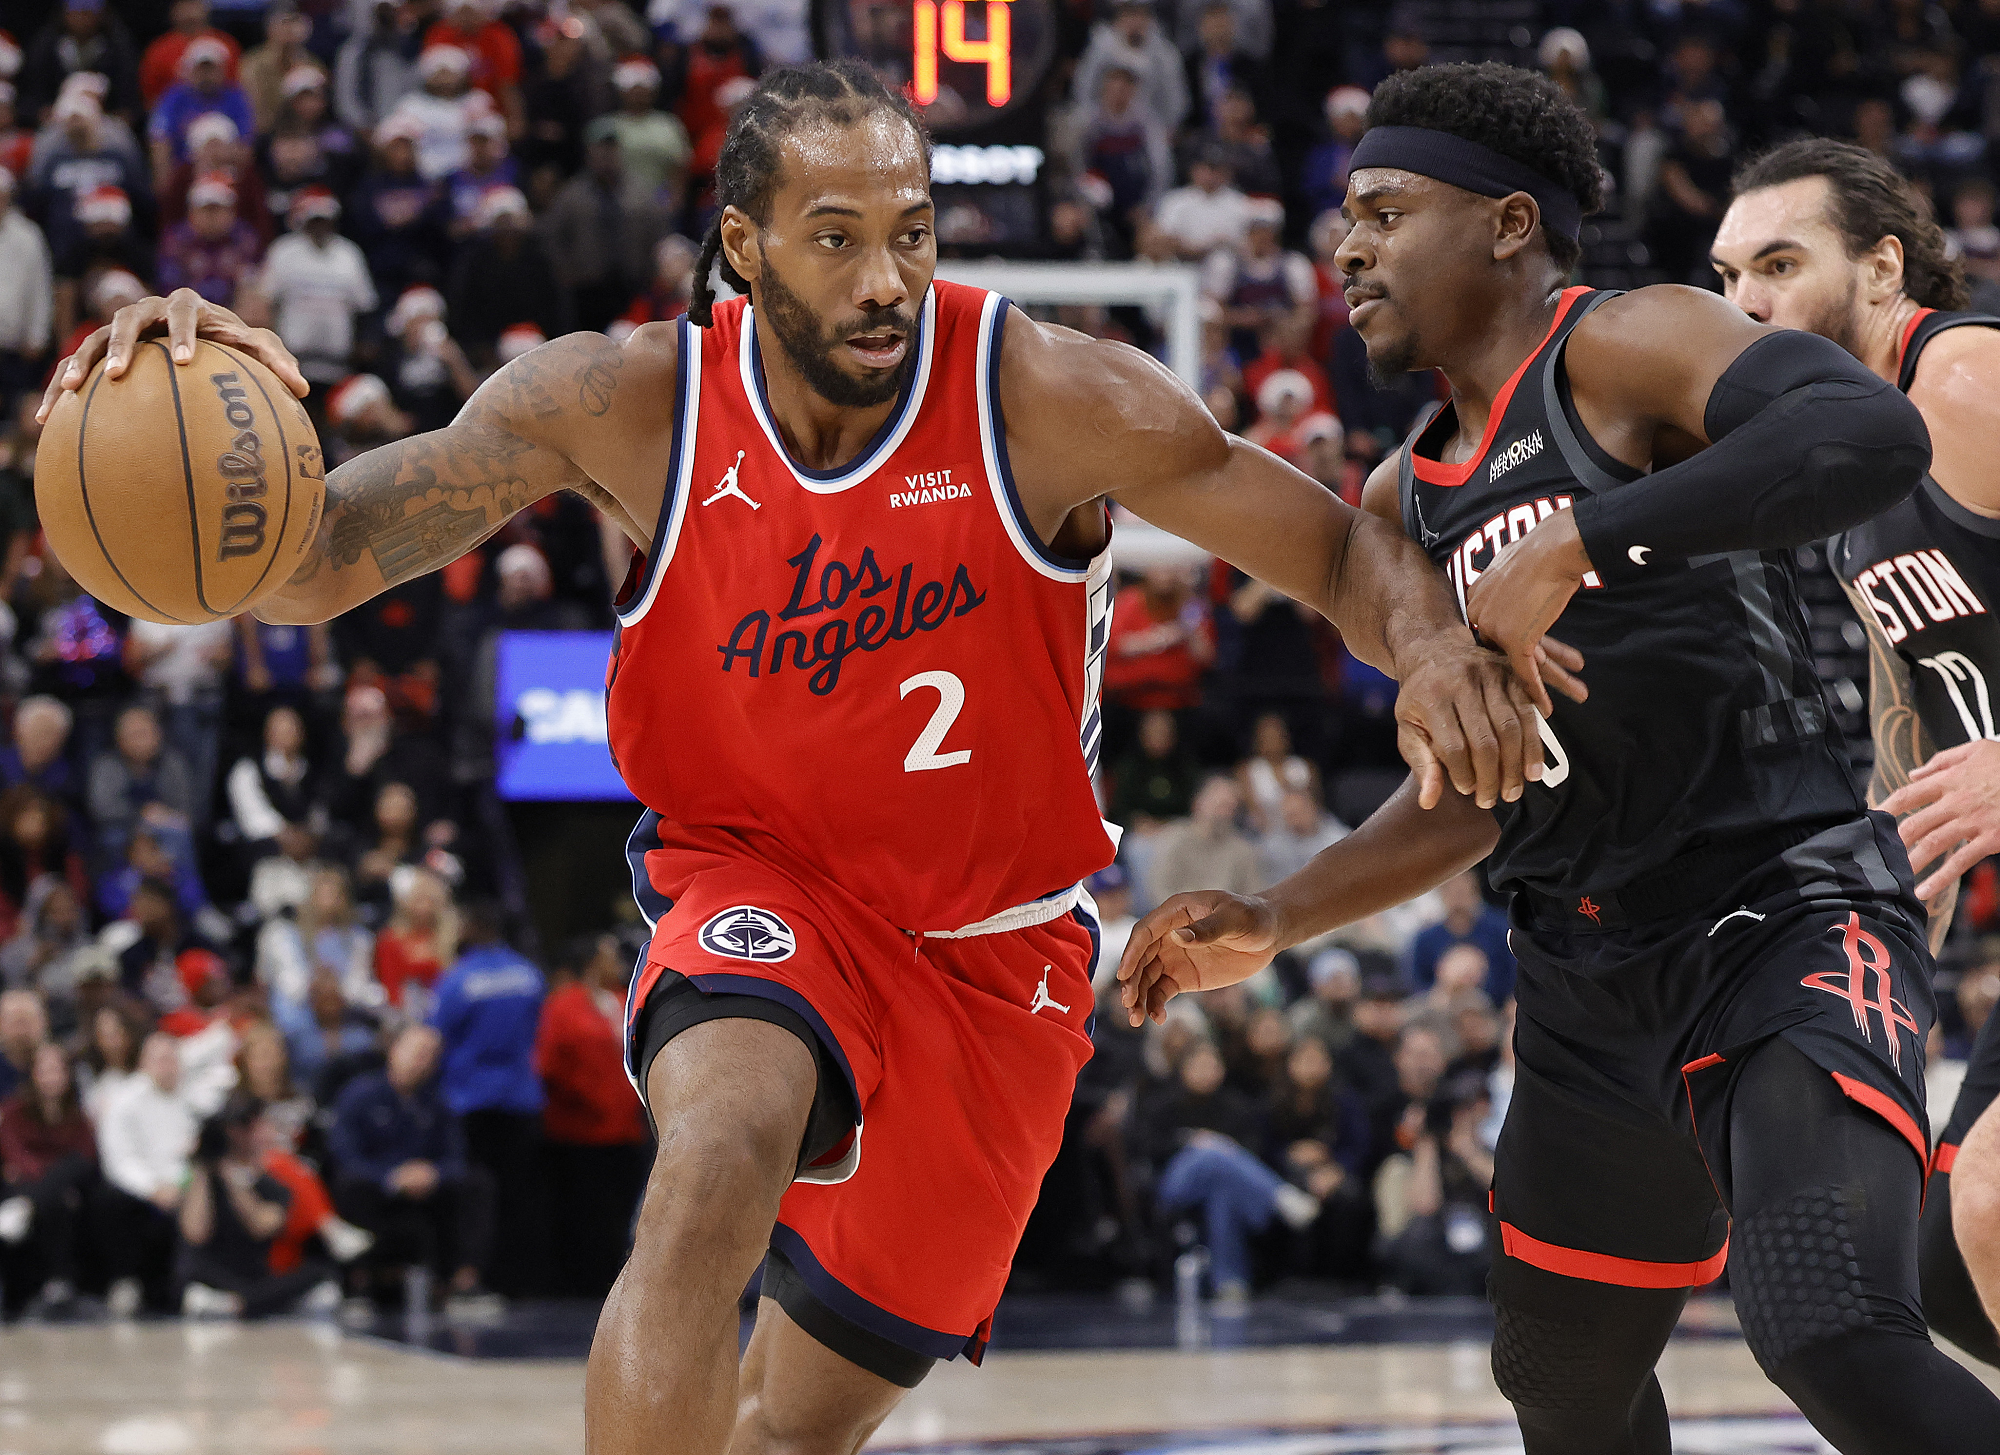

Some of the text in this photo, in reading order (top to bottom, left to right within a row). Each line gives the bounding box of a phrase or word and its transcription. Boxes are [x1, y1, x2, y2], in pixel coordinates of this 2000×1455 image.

[913, 0, 1012, 107] 14
[210, 371, 268, 562] Wilson
[905, 469, 952, 489] VISIT
[1489, 438, 1544, 484] HERMANN
[1490, 428, 1543, 470] MEMORIAL
[889, 484, 973, 508] RWANDA
[778, 532, 893, 621] Los
[716, 562, 987, 696] Angeles
[899, 669, 972, 773] 2
